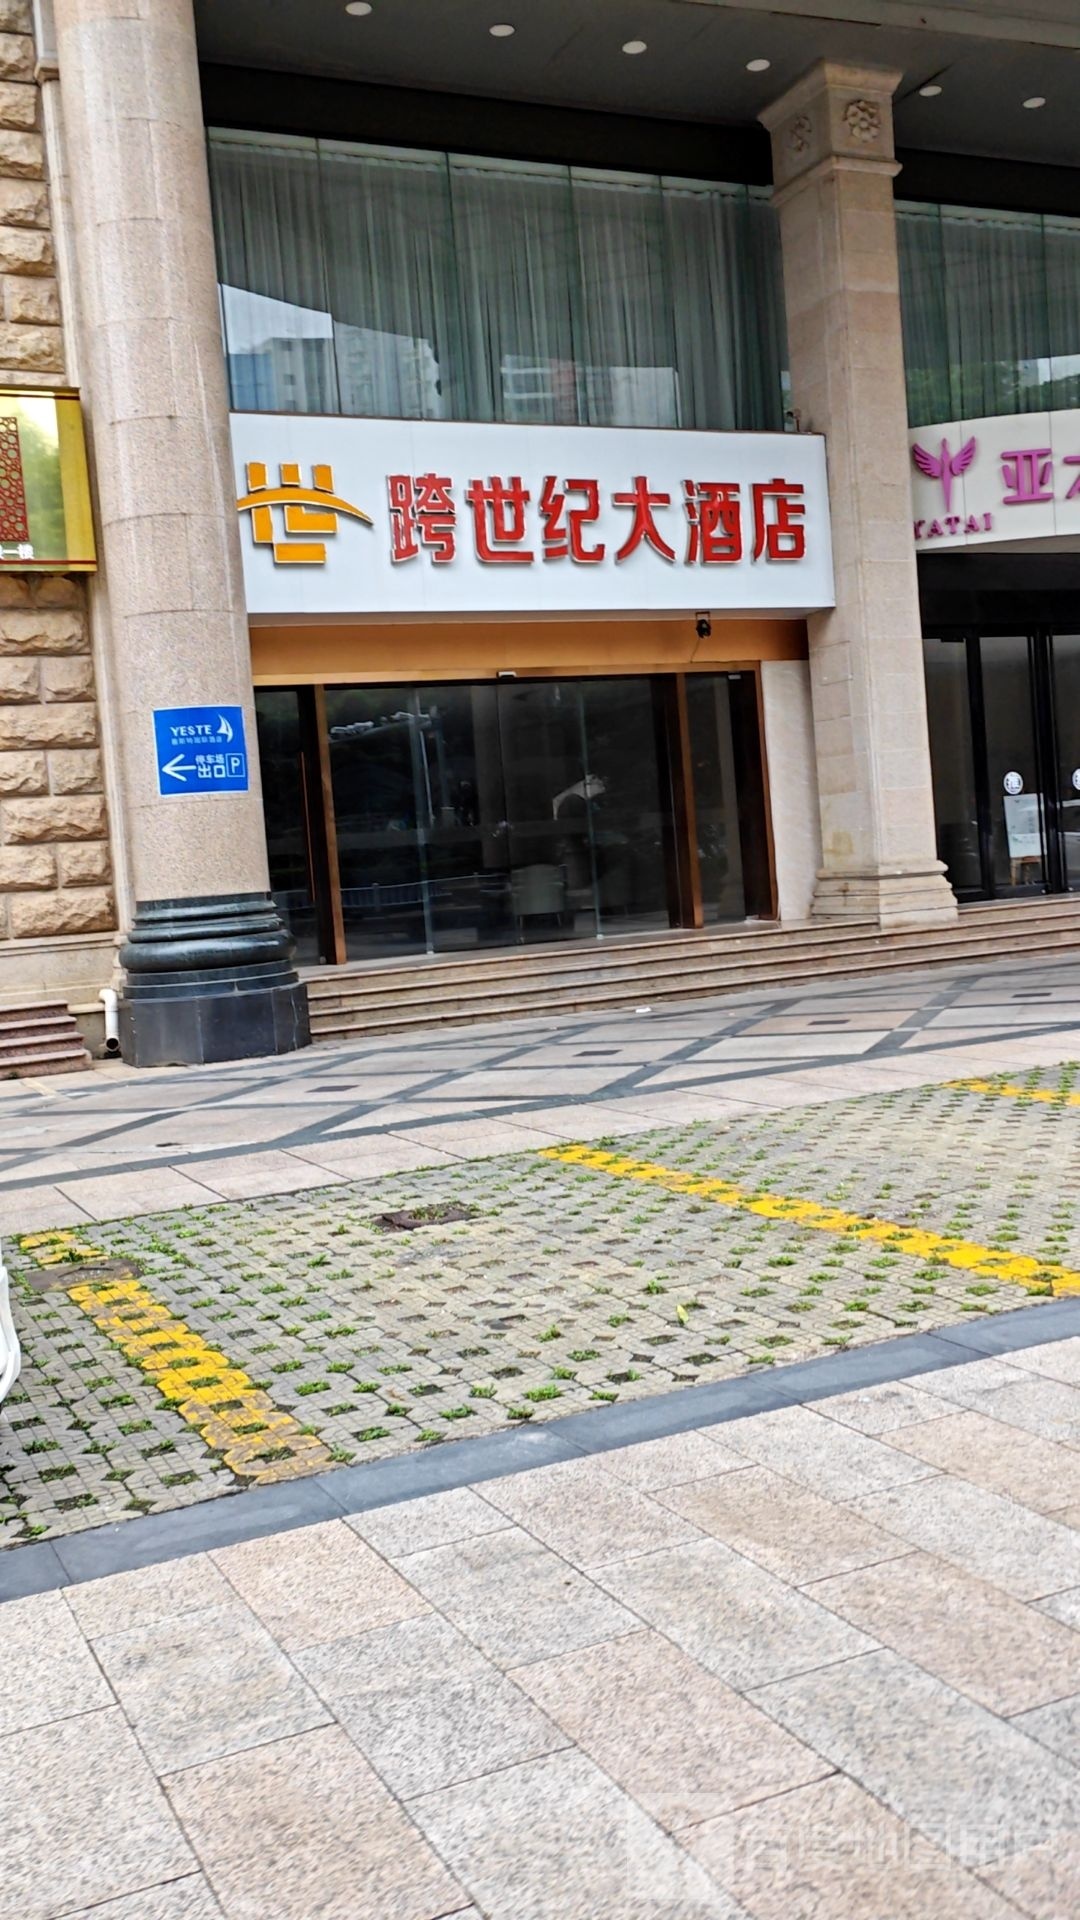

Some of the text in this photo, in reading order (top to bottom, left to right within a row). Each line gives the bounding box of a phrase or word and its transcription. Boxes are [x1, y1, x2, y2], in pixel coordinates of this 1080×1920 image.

[386, 473, 806, 565] 跨世纪大酒店
[914, 512, 992, 540] YATAI
[170, 725, 212, 736] YESTE
[198, 763, 226, 778] 出口
